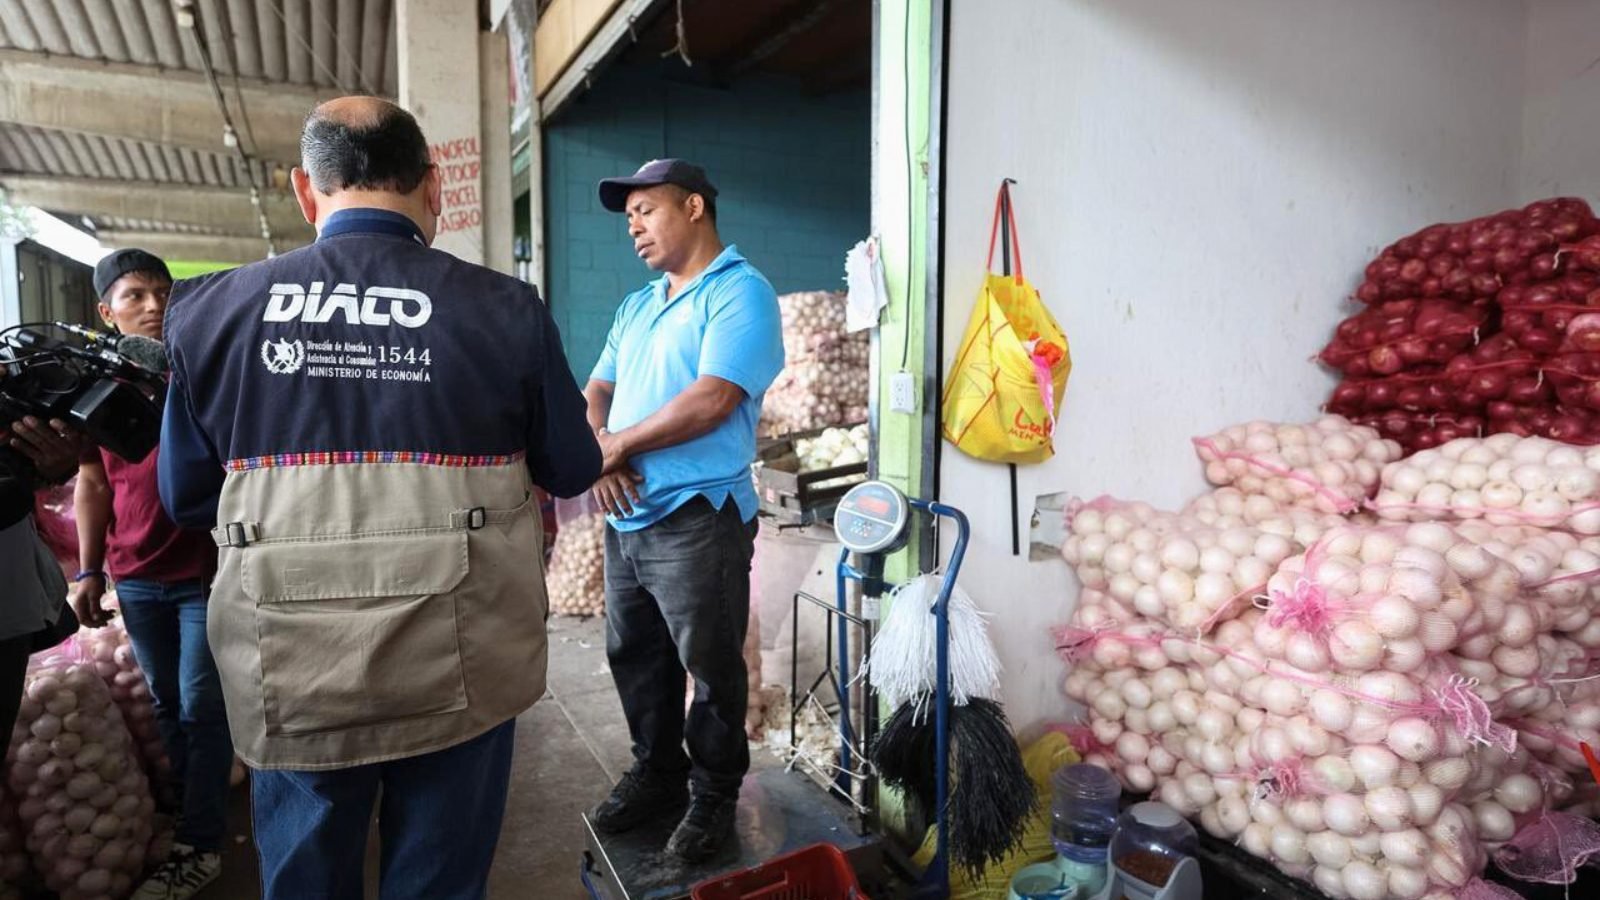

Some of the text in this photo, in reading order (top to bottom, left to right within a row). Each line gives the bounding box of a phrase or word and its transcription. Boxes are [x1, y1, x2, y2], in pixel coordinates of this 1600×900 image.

[335, 341, 341, 351] de
[378, 345, 431, 365] 1544
[308, 366, 431, 382] MINISTERIO DE ECONOMÍA
